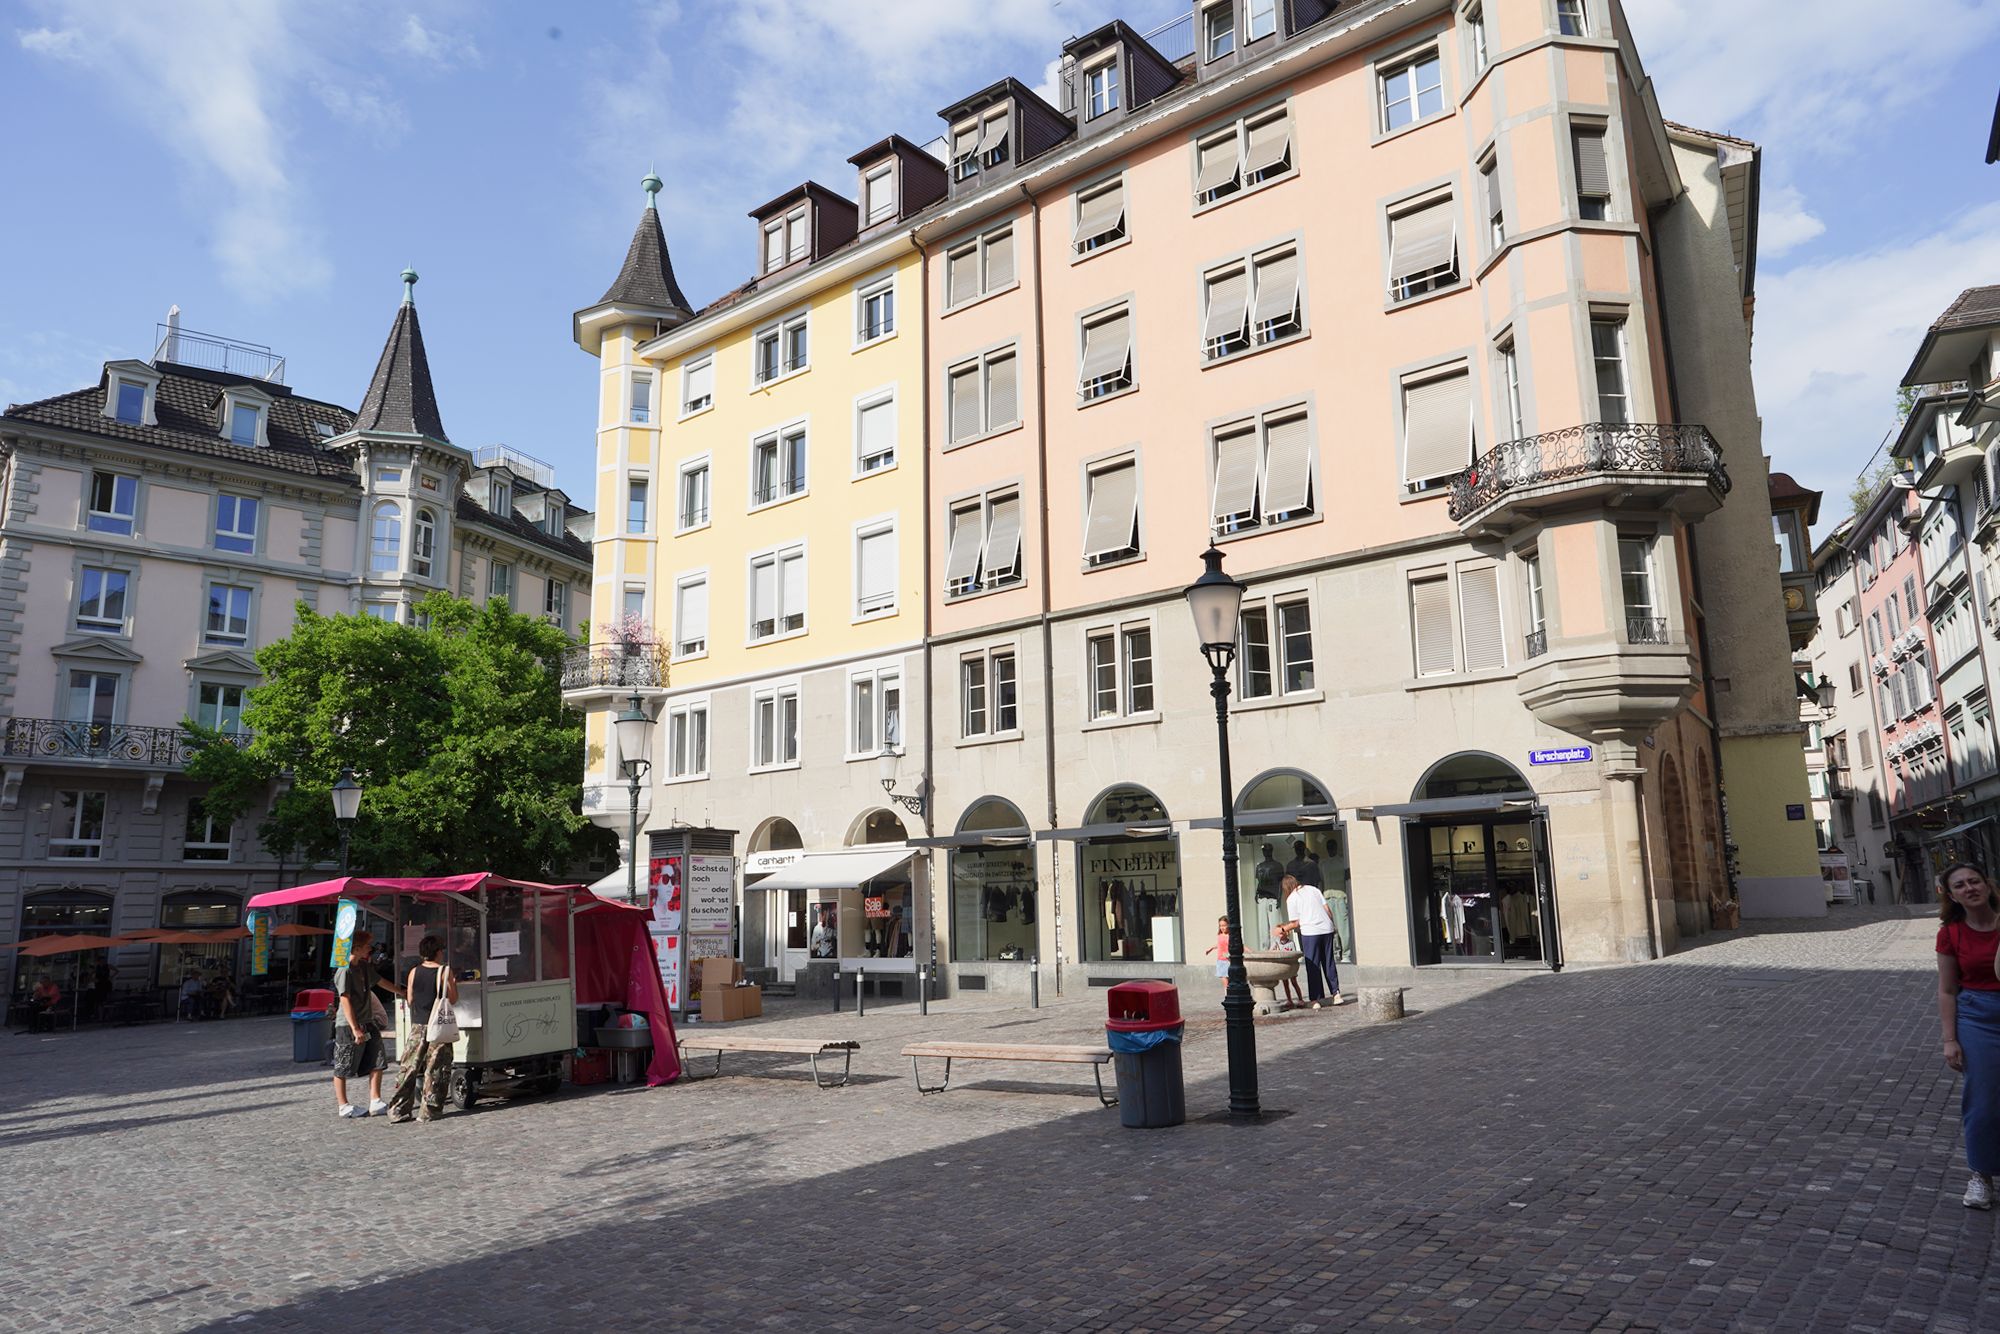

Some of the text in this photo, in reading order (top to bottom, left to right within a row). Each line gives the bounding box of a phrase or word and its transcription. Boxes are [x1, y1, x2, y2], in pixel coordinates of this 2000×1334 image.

[1535, 749, 1585, 762] Hirschenplatz
[1463, 841, 1476, 854] F
[757, 856, 795, 866] carhartt
[1090, 855, 1167, 873] FINELLI
[691, 864, 718, 872] Suchst
[691, 906, 729, 914] du schon?
[865, 898, 881, 912] Sale
